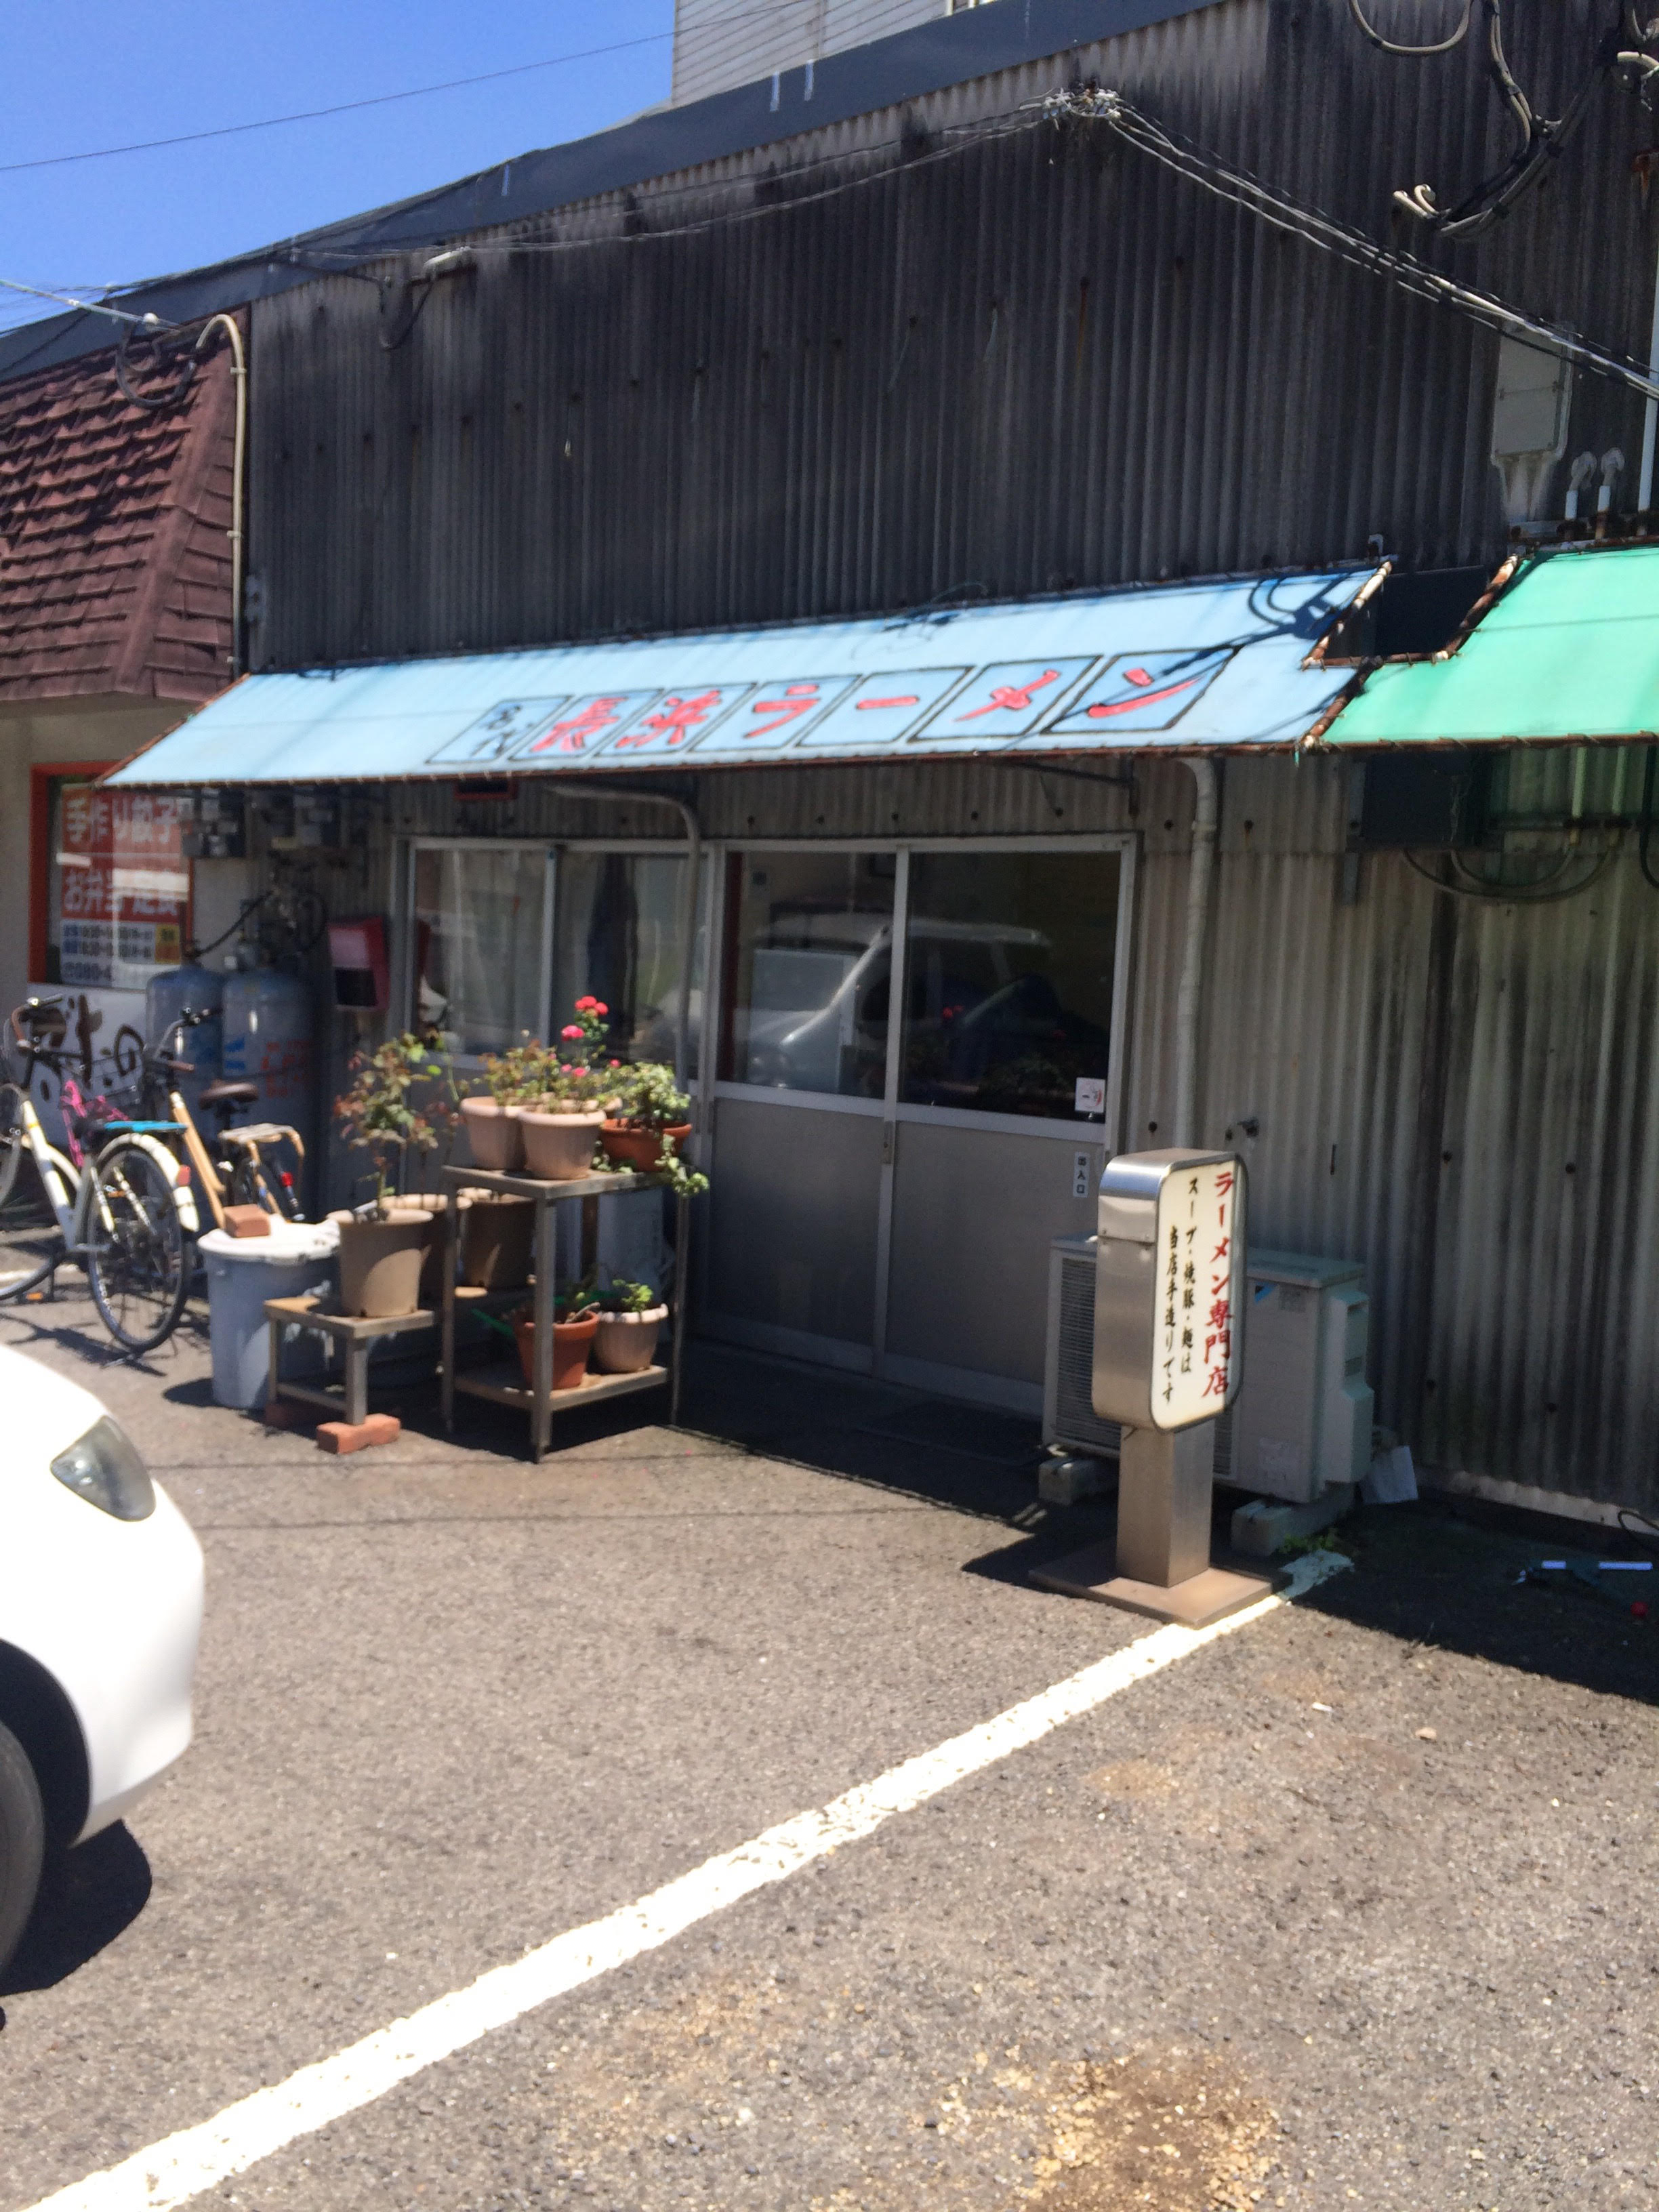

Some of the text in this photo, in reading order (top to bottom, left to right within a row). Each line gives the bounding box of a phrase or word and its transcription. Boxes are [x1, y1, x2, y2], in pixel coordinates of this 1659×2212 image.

[527, 668, 1202, 753] 長浜ラーメン
[1076, 1155, 1087, 1195] 出入口
[1202, 1171, 1234, 1397] ラーメン専門店
